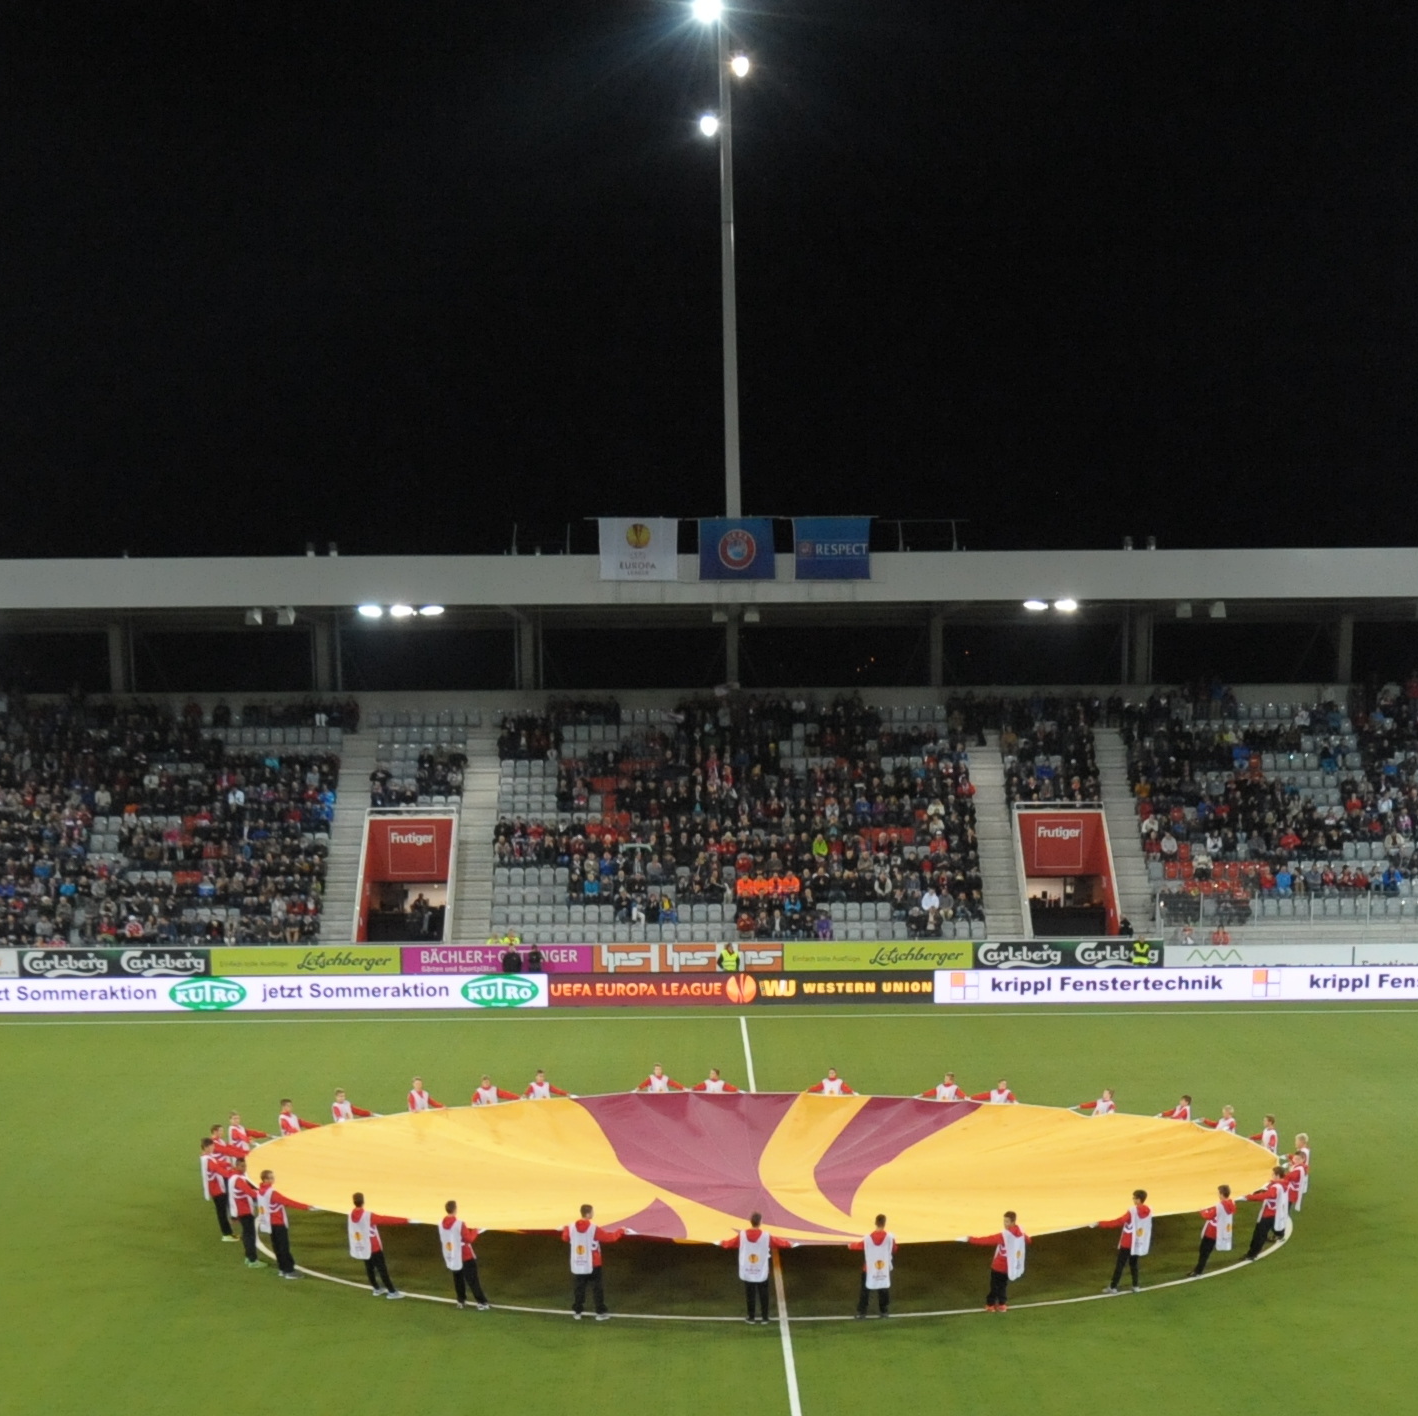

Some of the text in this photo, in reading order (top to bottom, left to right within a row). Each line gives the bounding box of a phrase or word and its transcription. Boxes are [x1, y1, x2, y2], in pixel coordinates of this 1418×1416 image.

[815, 543, 868, 555] RESPECT
[391, 832, 433, 845] Frutiger
[1038, 826, 1080, 840] Frutiger
[120, 952, 205, 976] Carlsberg
[977, 943, 1062, 968] Carlsberg
[23, 952, 108, 978] Carlsberg
[175, 980, 241, 1002] KUTRO
[467, 978, 533, 1000] KUTRO
[550, 982, 722, 996] UEFA EUROPA LEAGUE
[763, 980, 933, 997] WU WESTERN UNION
[991, 975, 1223, 995] krippl Fenstertechnik
[1309, 974, 1370, 992] krippl
[16, 985, 157, 1001] Sommeraktion
[261, 983, 449, 1002] jetzt Sommeraktion
